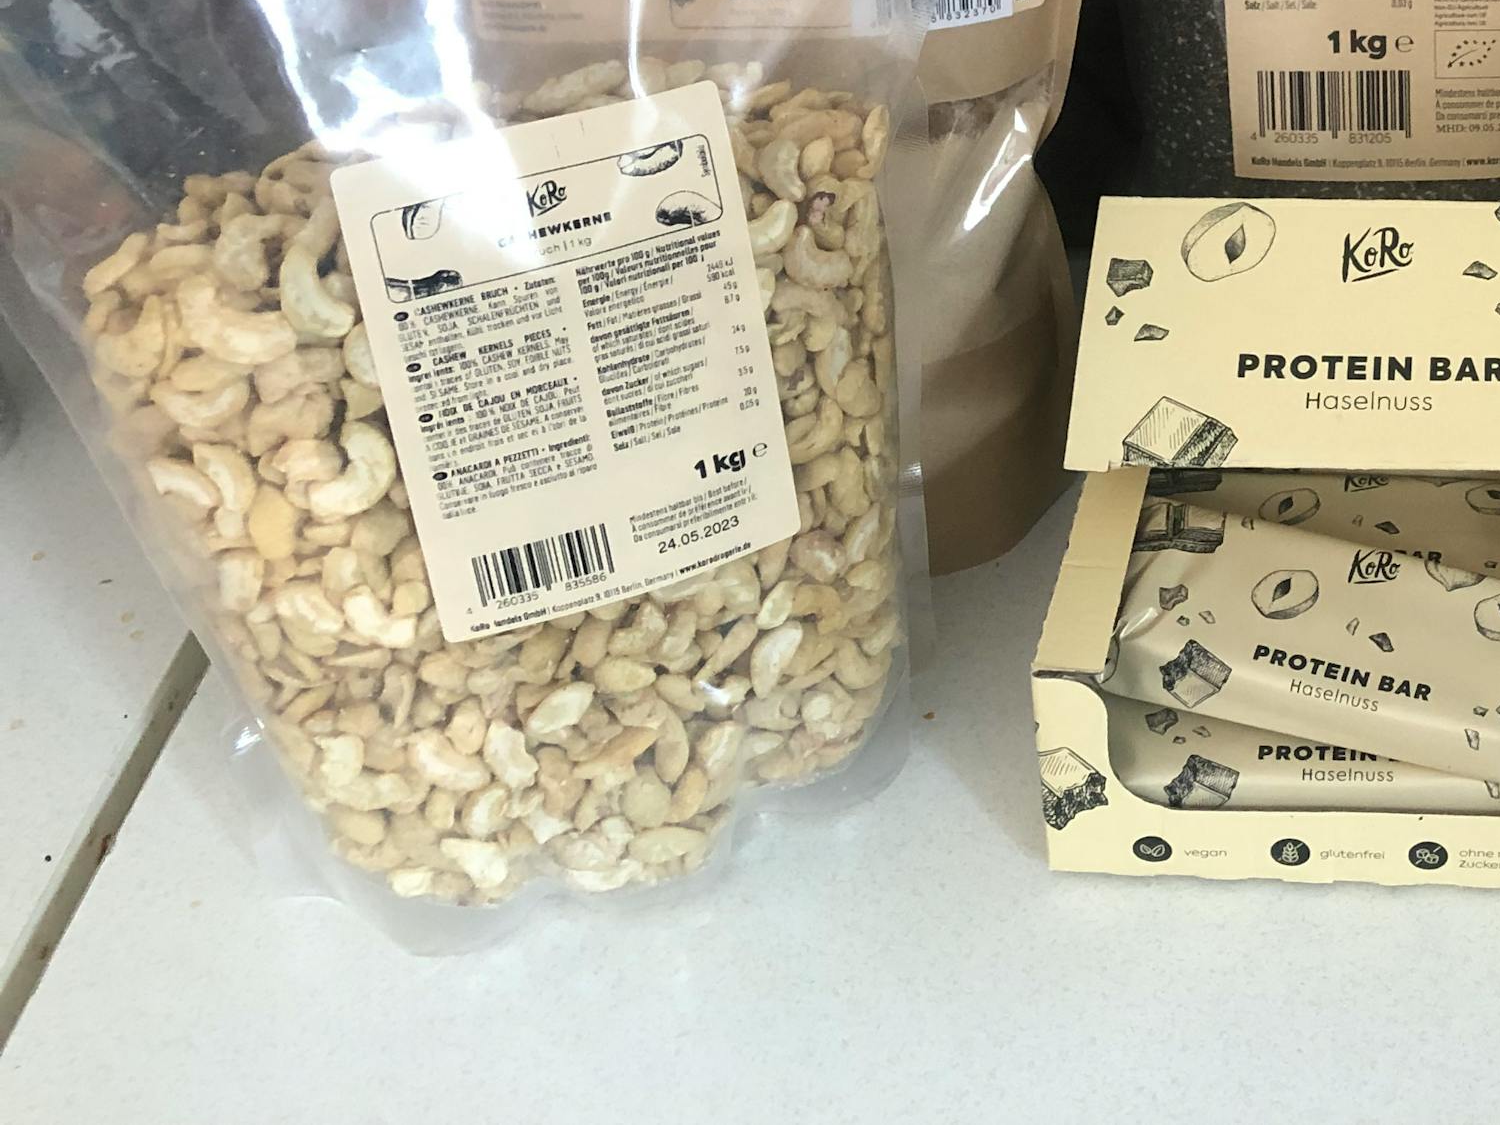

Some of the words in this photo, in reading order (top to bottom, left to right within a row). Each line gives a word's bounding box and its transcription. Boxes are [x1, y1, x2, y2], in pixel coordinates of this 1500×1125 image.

[1327, 30, 1340, 54] 1
[1351, 29, 1387, 59] kg
[1250, 131, 1257, 141] 4
[1274, 133, 1319, 144] 260335
[1348, 133, 1392, 144] 831205
[525, 179, 568, 217] KoRo
[1340, 225, 1414, 283] KoRo
[1237, 353, 1414, 381] PROTEIN
[1304, 390, 1434, 412] Haselnuss
[693, 459, 707, 479] 1
[714, 449, 746, 477] kg
[657, 515, 740, 555] 24.05.2023
[1347, 548, 1401, 584] KoRo
[496, 592, 540, 610] 260335
[564, 573, 608, 592] 835586
[1253, 643, 1372, 689] PROTEIN
[1377, 674, 1433, 702] BAR
[1289, 677, 1381, 713] Haselnuss
[1301, 766, 1396, 784] Haselnuss
[1184, 847, 1228, 860] vegan
[1319, 846, 1387, 862] glutenfrei
[1458, 848, 1496, 859] ohne
